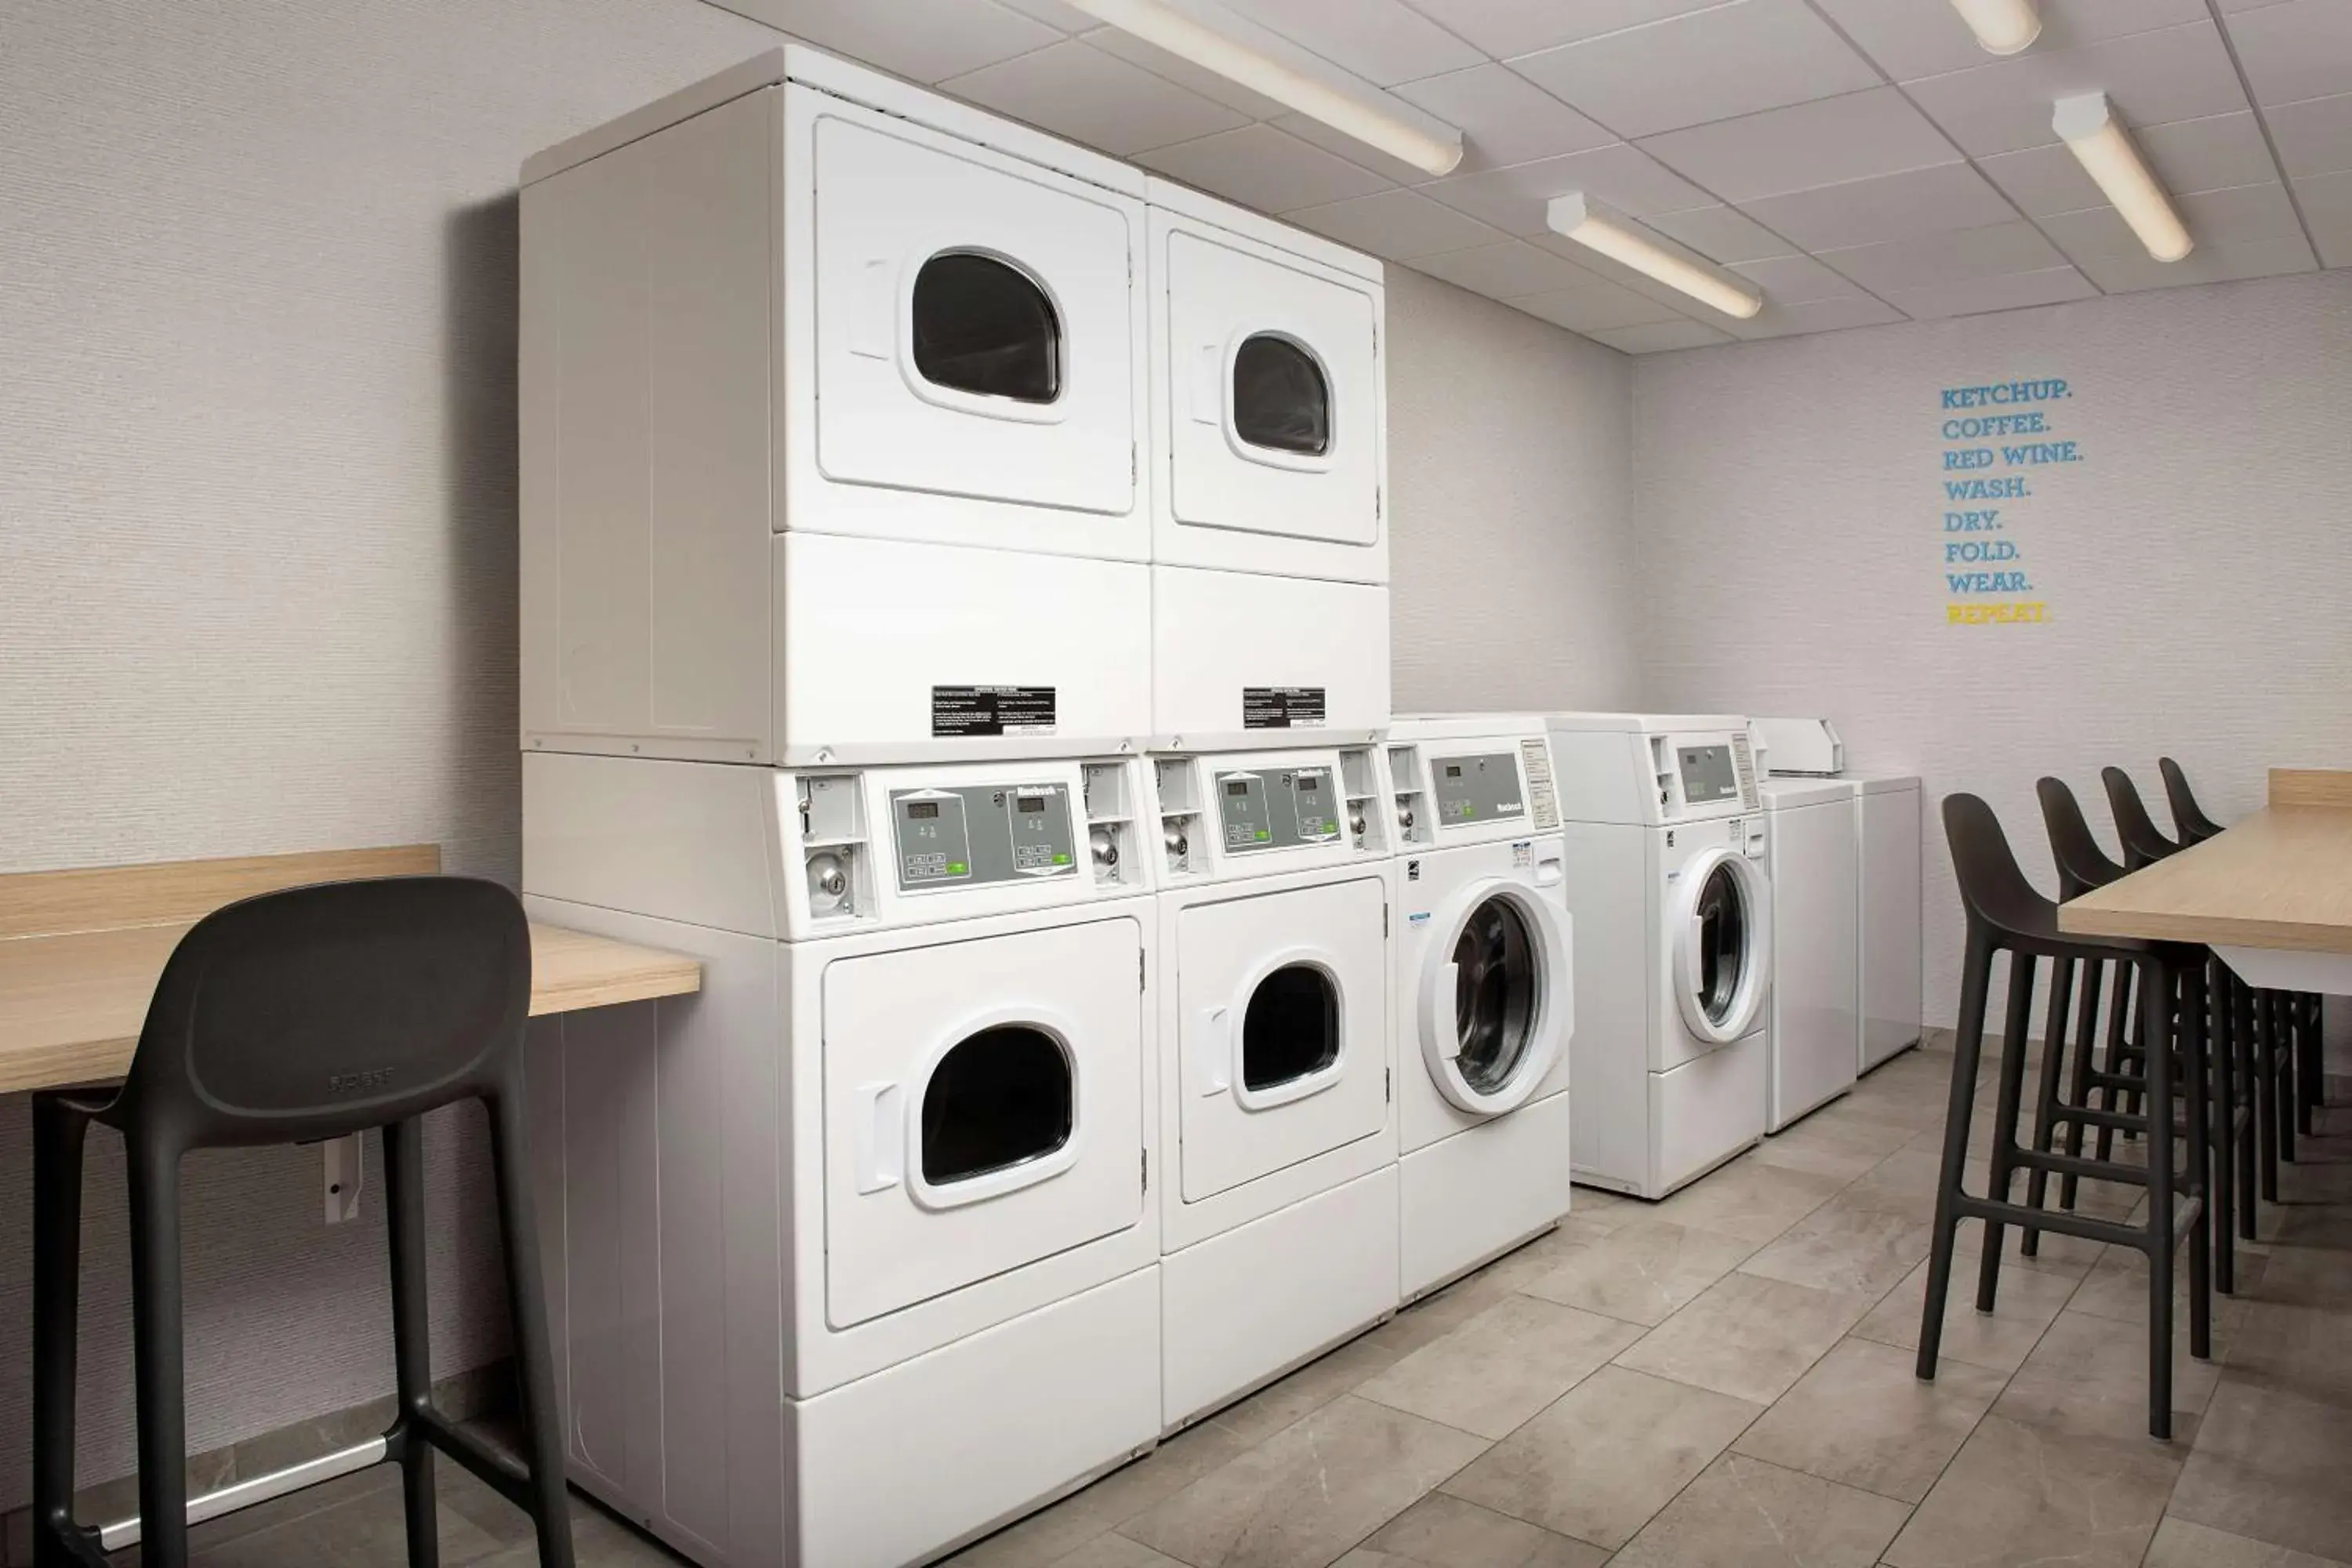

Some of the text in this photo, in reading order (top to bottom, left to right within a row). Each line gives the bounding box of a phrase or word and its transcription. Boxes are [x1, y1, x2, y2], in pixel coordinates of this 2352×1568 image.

[1940, 378, 2072, 408] KETCHUP.
[1942, 412, 2051, 439] COFFEE.
[1943, 441, 2083, 470] RED WINE.
[1944, 477, 2031, 500] WASH.
[1944, 510, 2002, 532] DRY.
[1945, 539, 2020, 562] FOLD.
[1947, 572, 2033, 593] WEAR.
